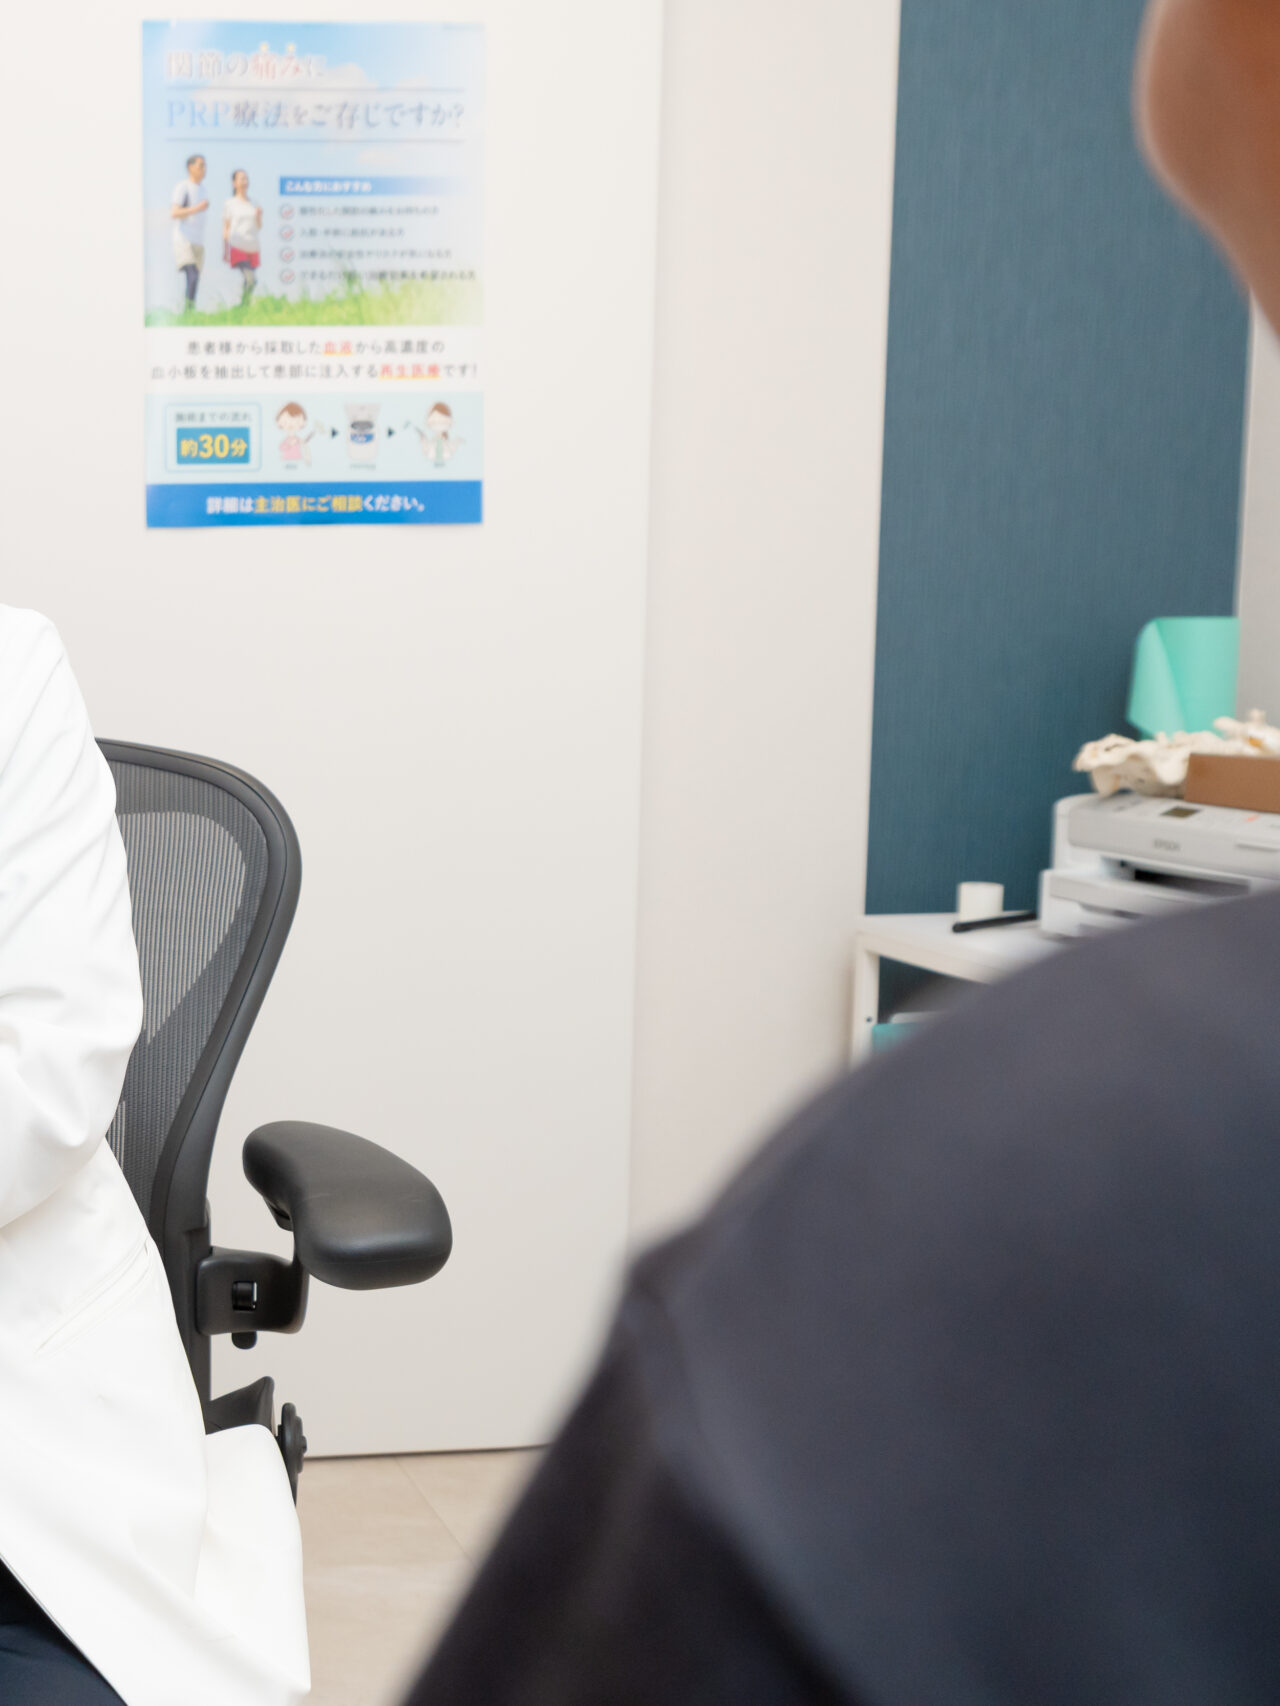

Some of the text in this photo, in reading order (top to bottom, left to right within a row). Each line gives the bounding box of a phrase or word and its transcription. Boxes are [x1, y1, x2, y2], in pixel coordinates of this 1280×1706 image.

[167, 51, 326, 80] 関節の痛みに
[180, 434, 248, 458] 約30分
[206, 494, 425, 515] 詳細は主治医にご相談ください。
